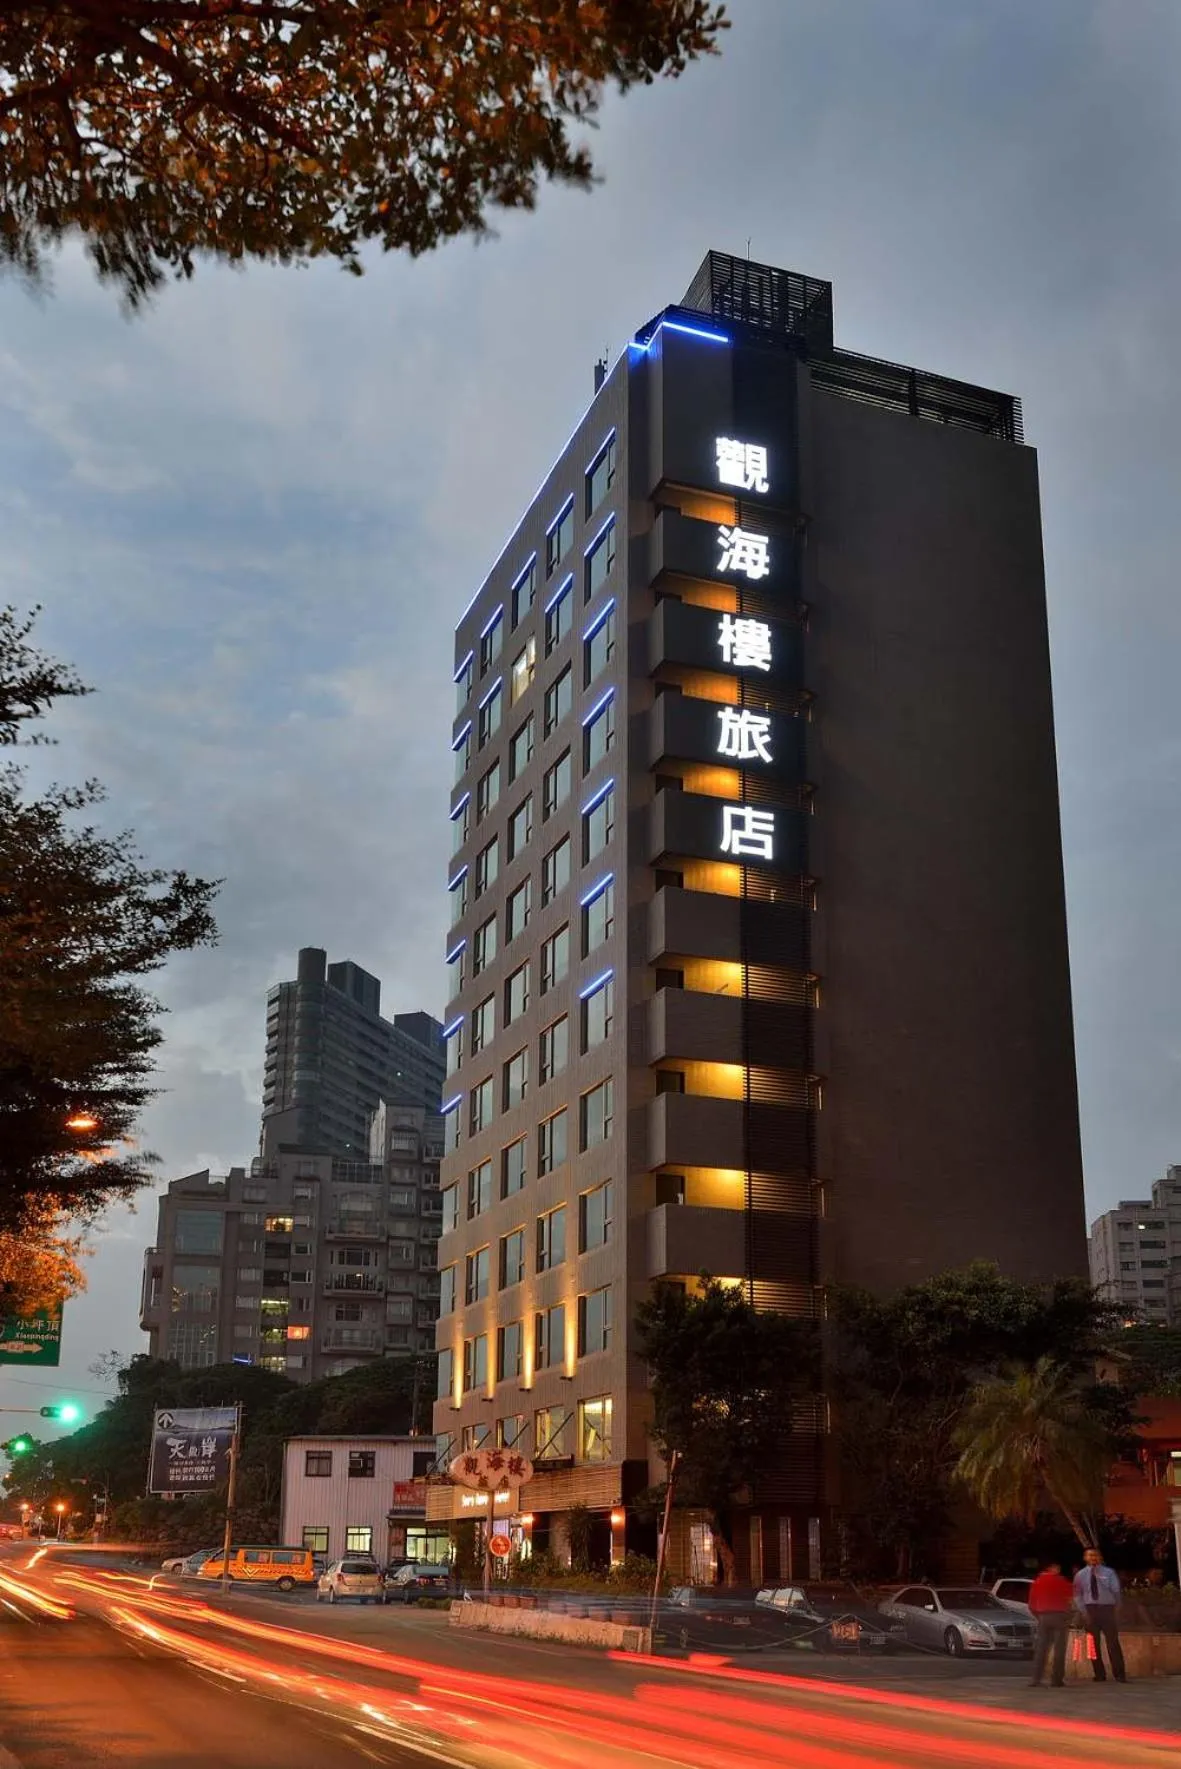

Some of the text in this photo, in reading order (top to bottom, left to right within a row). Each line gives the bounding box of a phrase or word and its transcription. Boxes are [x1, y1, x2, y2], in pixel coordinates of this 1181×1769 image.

[715, 435, 776, 861] 觀海樓旅店
